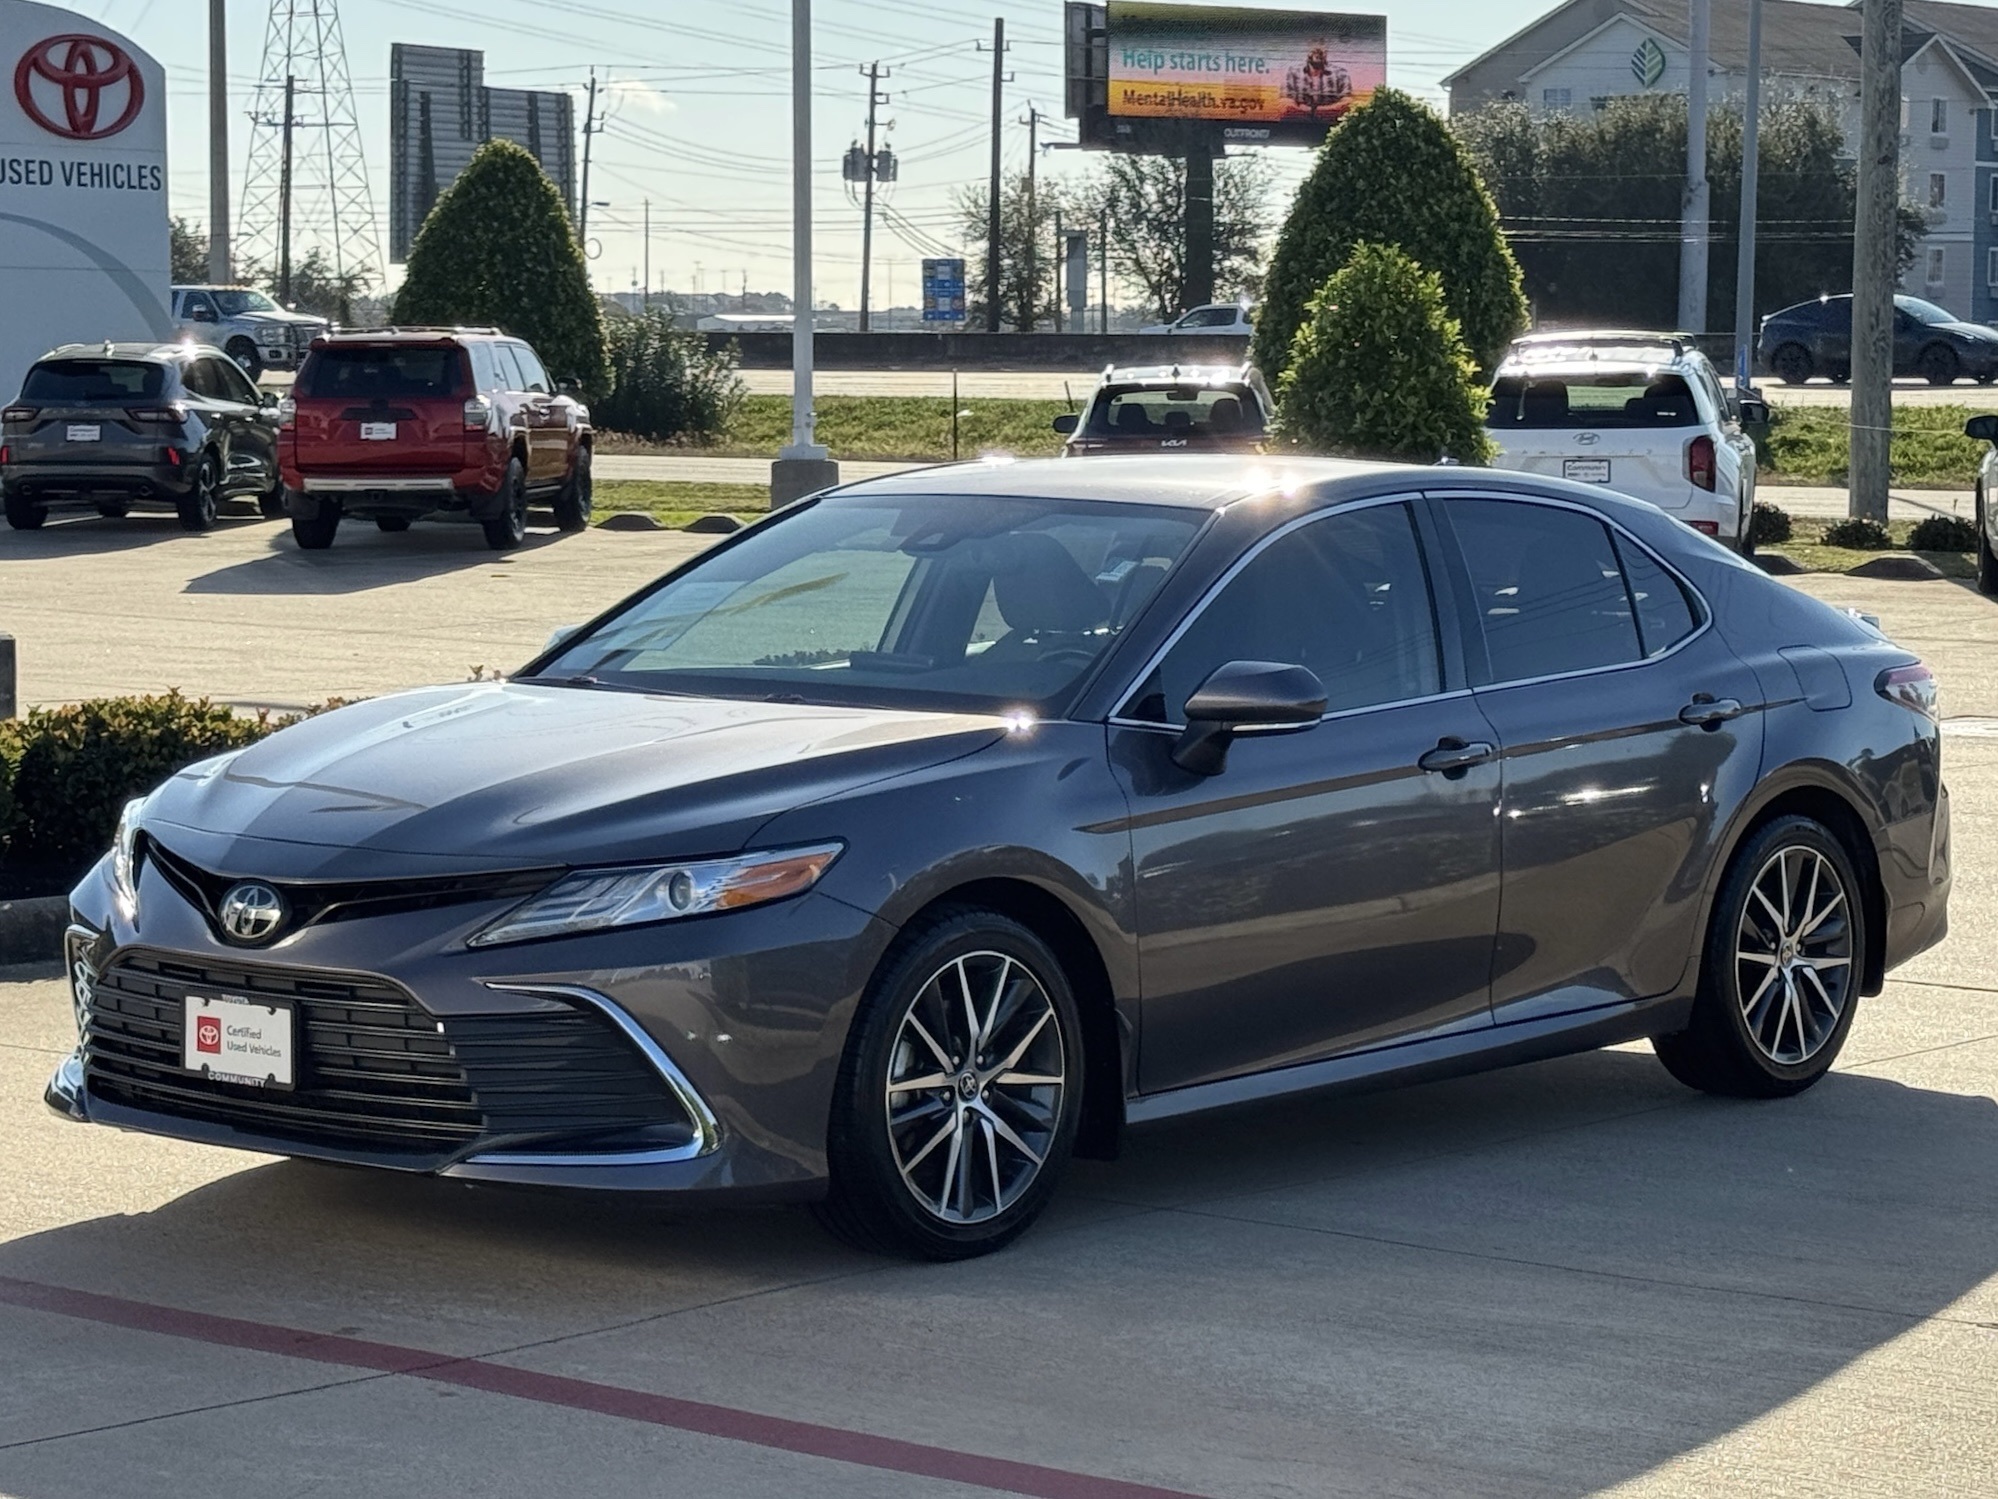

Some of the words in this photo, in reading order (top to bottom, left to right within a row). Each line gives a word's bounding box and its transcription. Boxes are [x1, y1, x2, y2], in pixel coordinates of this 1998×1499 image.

[1122, 50, 1165, 75] Help
[1169, 52, 1220, 72] starts
[1224, 52, 1270, 74] here.
[60, 161, 161, 191] VEHICLES
[226, 1025, 262, 1040] Certified
[227, 1041, 247, 1053] Used
[249, 1044, 282, 1058] Vehicles
[208, 1070, 265, 1088] COMMUNITY
